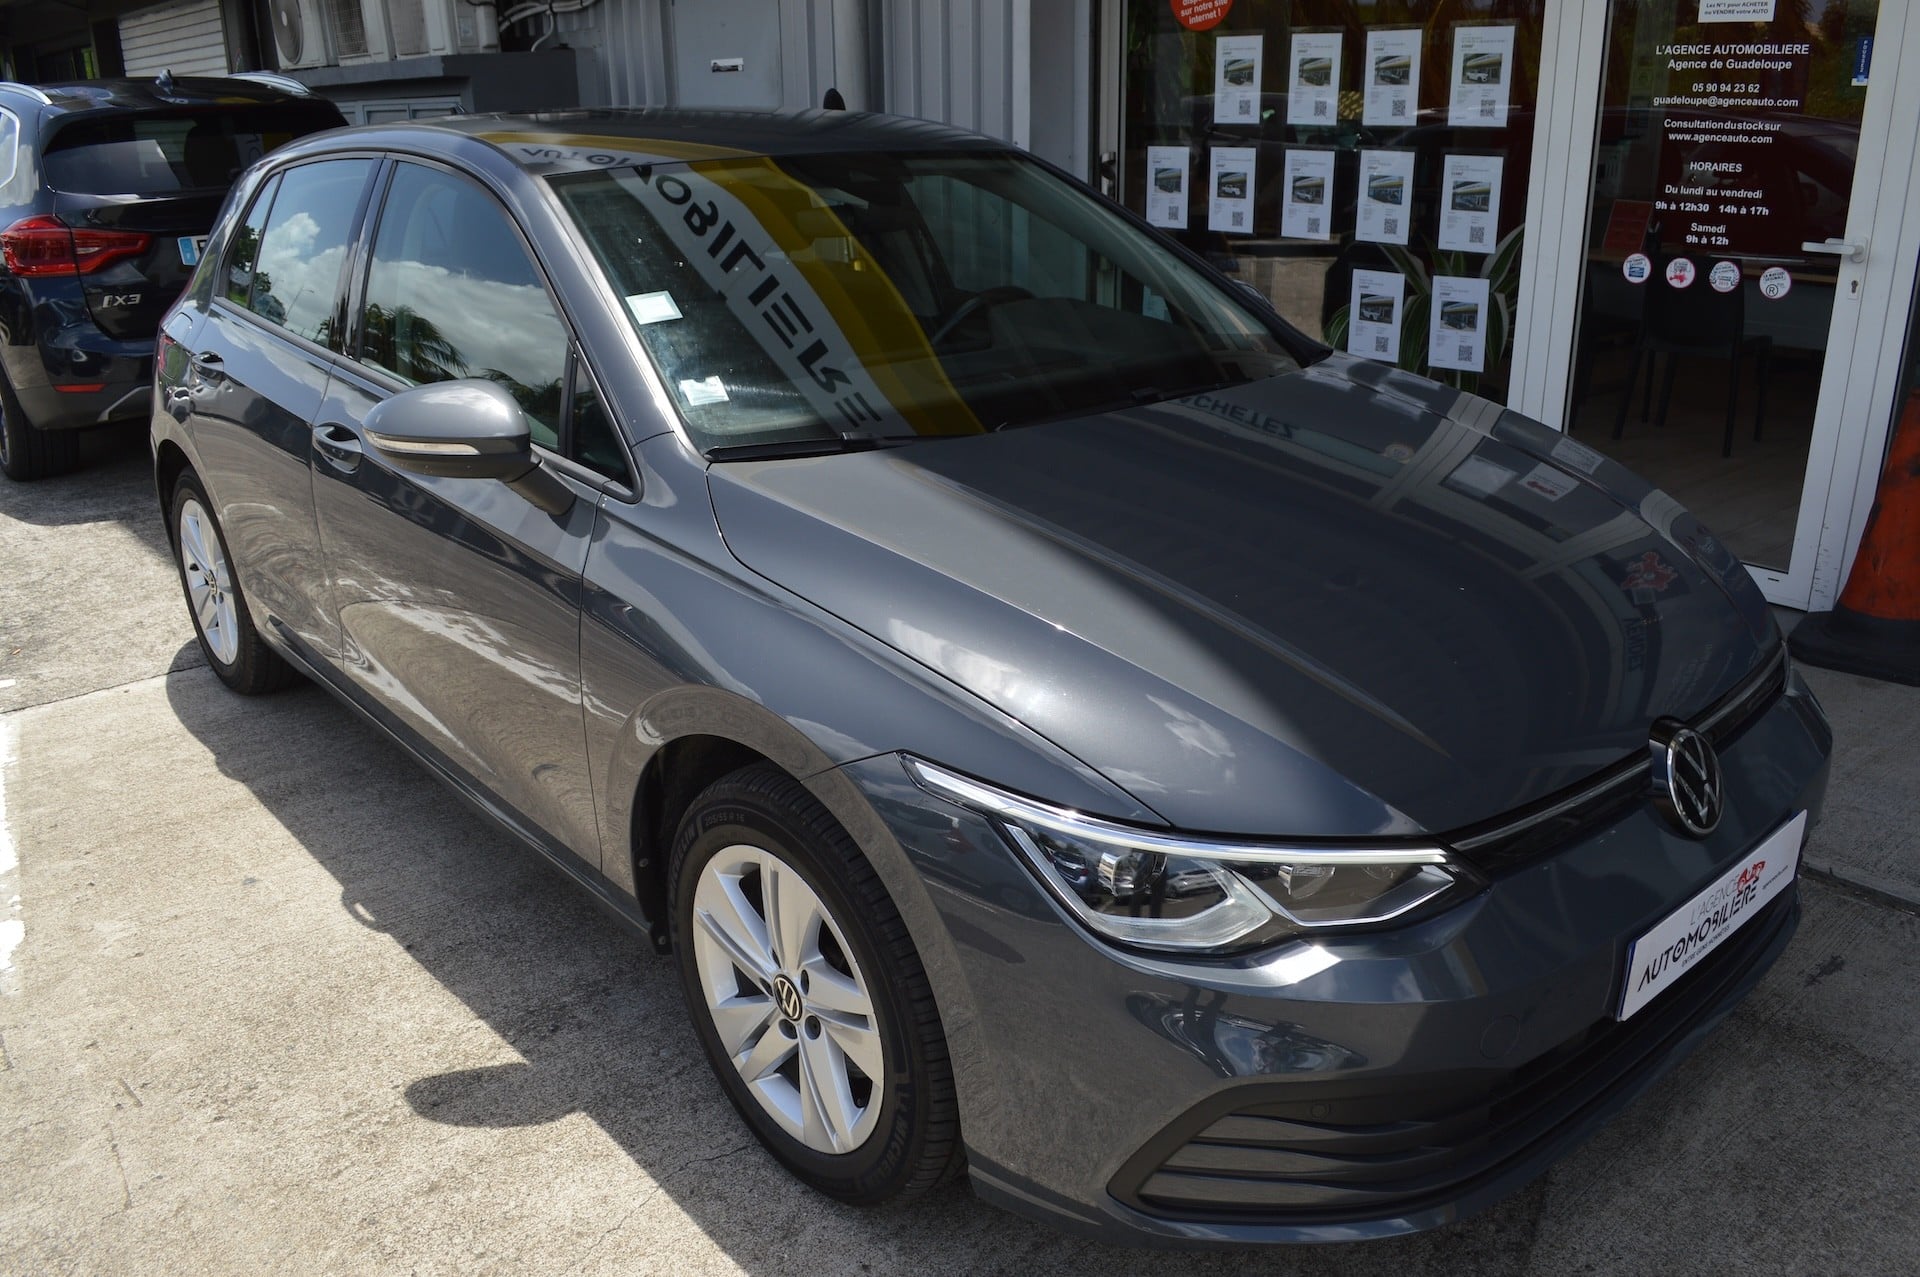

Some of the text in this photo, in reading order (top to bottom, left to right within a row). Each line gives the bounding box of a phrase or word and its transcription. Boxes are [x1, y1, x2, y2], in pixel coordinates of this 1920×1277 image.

[1180, 7, 1193, 17] sur
[1194, 2, 1213, 13] notre
[1655, 43, 1810, 55] L'AGENCE AUTOMOBILIERE
[1667, 59, 1793, 71] Agence de Guadeloupe
[1692, 83, 1760, 93] 05 90 94 23 62
[1653, 95, 1799, 108] guadeloupe@agenceauto.com
[1668, 133, 1773, 144] www.agenceauto.com
[1690, 161, 1743, 173] HORAIRES
[1665, 185, 1763, 199] Du lundi au vendredi
[1655, 201, 1769, 216] 9h à 12h30 14h à 17h
[1690, 222, 1726, 233] Samedi
[1686, 235, 1729, 245] 9h à 12h
[1637, 876, 1760, 992] AUTOMOBILIERE
